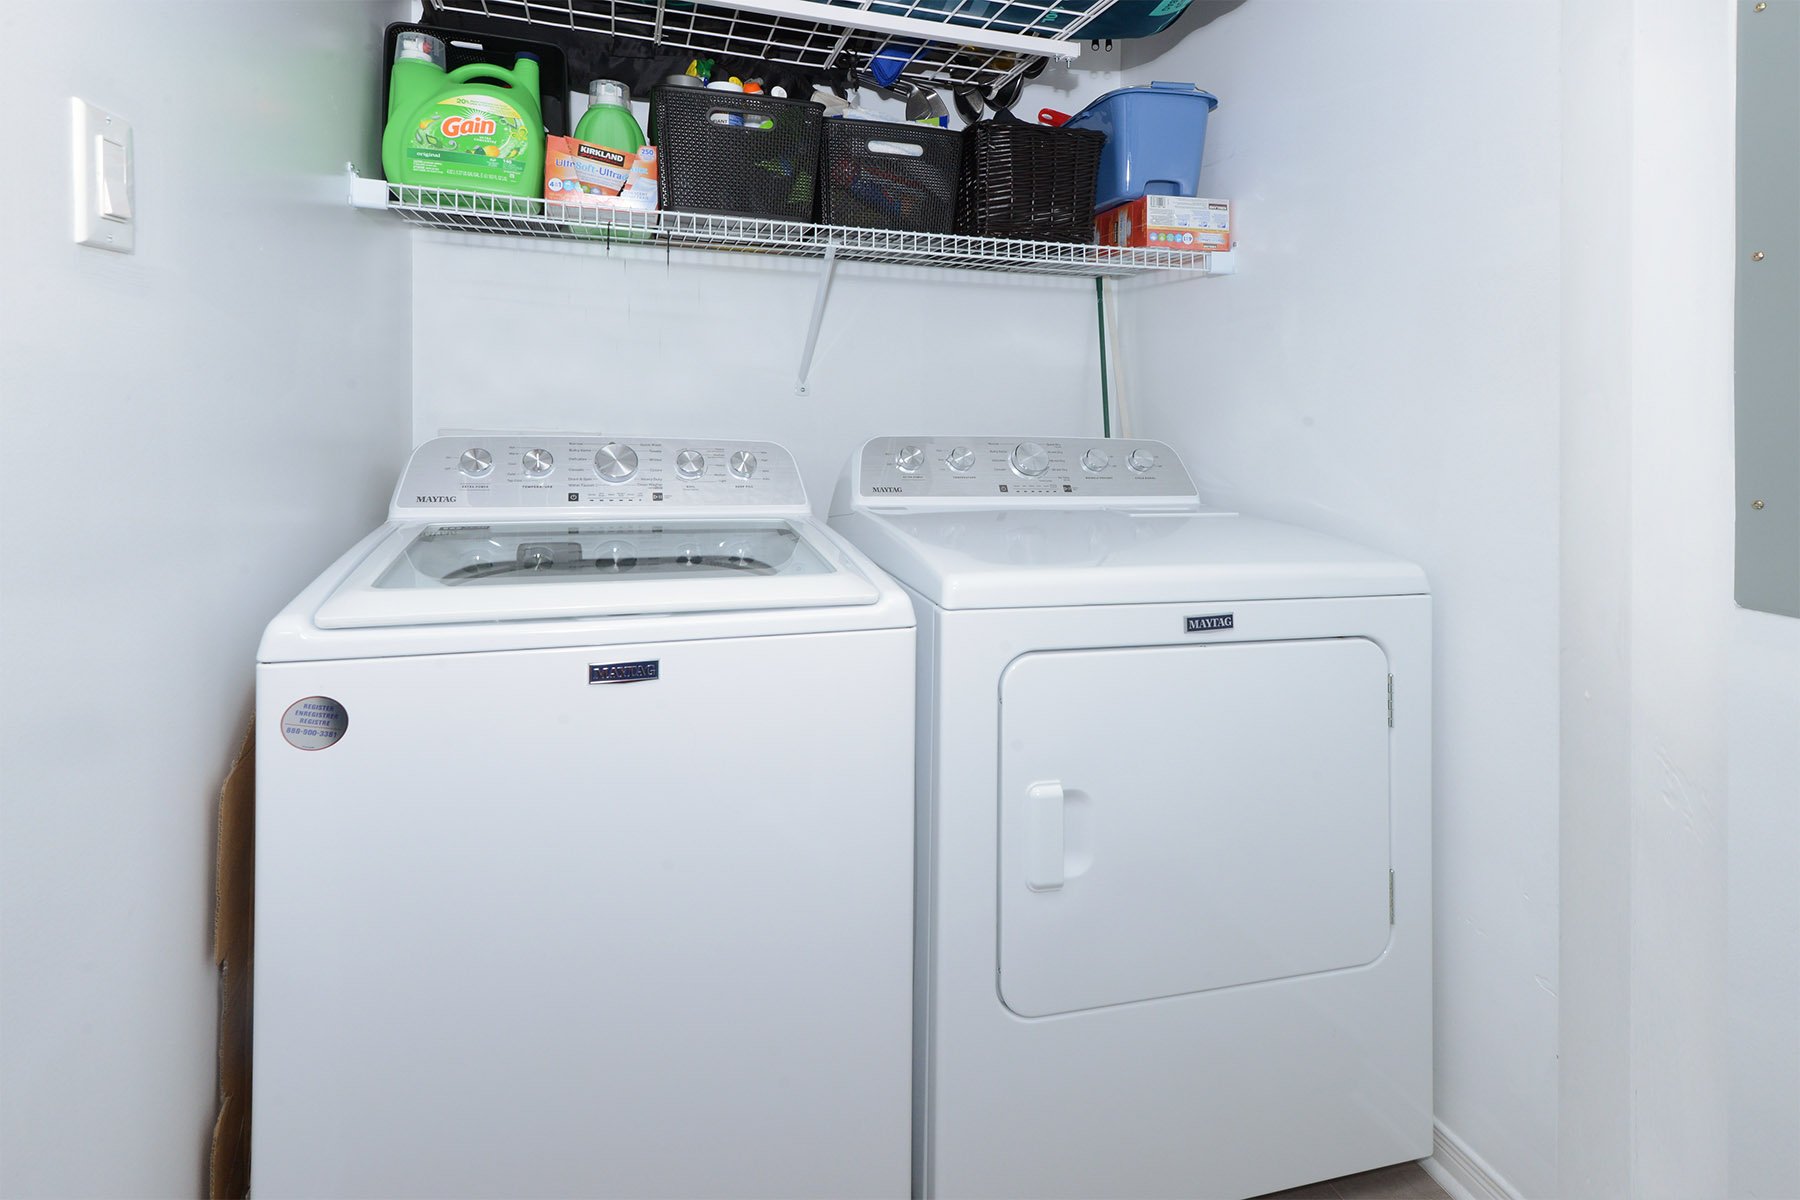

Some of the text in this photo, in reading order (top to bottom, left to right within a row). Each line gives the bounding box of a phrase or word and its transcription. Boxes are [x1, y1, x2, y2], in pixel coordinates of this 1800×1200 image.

[442, 116, 495, 137] Gain
[416, 151, 441, 159] original
[580, 145, 624, 162] KIRKLAND
[1189, 616, 1232, 630] MAYTAG
[593, 664, 656, 680] MAYTAG
